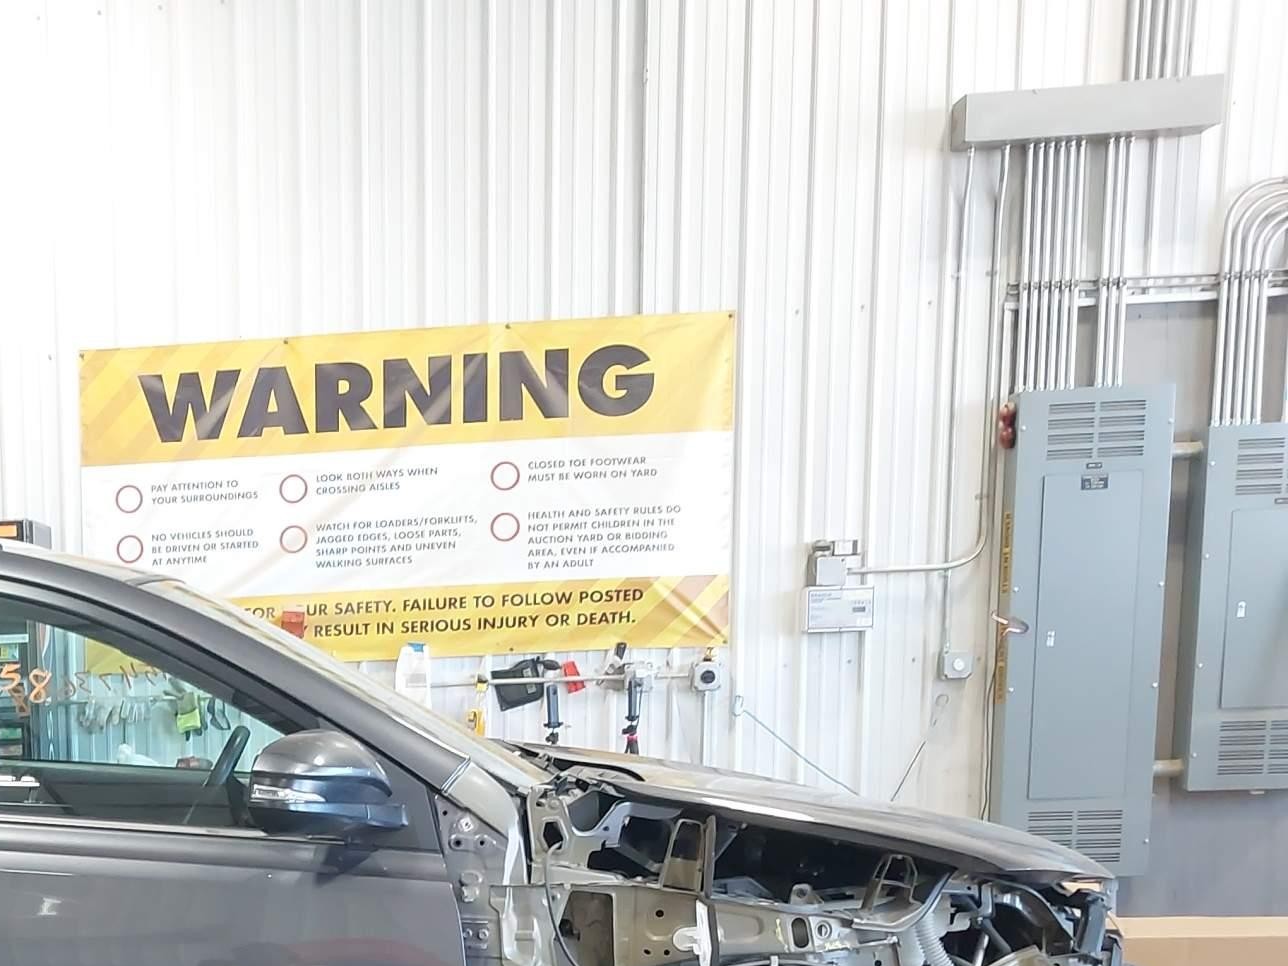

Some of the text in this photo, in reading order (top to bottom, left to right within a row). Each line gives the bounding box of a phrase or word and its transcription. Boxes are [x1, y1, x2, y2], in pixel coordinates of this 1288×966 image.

[137, 343, 655, 443] WARNING
[528, 456, 646, 470] CLOSED TOE FOOTWEAR
[316, 467, 438, 483] LOOK BOTH WAYS WHEN
[528, 468, 658, 482] MUST BE WORN ON YARD
[151, 479, 239, 493] PAY ATTENTION TO
[316, 482, 401, 495] CROSSING AISLES
[151, 491, 259, 505] YOUR SURROUNDINGS
[528, 505, 682, 520] HEALTH AND SAFETY RULES DO
[316, 515, 478, 532] WATCH FOR LOADERS/FORKLIFTS,
[528, 518, 675, 532] NOT PERMIT CHILDREN IN THE
[151, 528, 254, 542] NO VEHICLES SHOULD
[316, 528, 462, 544] JAGGED EDGES, LOOSE PARTS,
[528, 530, 668, 545] AUCTION YARD OR BIDDING
[151, 540, 259, 554] BE DRIVEN OR STARTED
[316, 541, 456, 556] SHARP POINTS AND UNEVEN
[528, 543, 675, 557] AREA, EVEN IF ACCOMPANIED
[152, 556, 208, 566] AT ANYTIME
[316, 556, 413, 569] WALKING SURFACES
[528, 559, 594, 570] BY AN ADULT
[334, 600, 396, 615] SAFETY.
[402, 596, 467, 612] FAILURE
[473, 595, 495, 609] TO
[502, 591, 573, 607] FOLLOW
[579, 588, 644, 604] POSTED
[314, 622, 370, 638] RESULT
[376, 621, 394, 635] IN
[401, 618, 471, 634] SERIOUS
[477, 614, 540, 630] INJURY
[546, 613, 569, 627] OR
[577, 610, 636, 626] DEATH.
